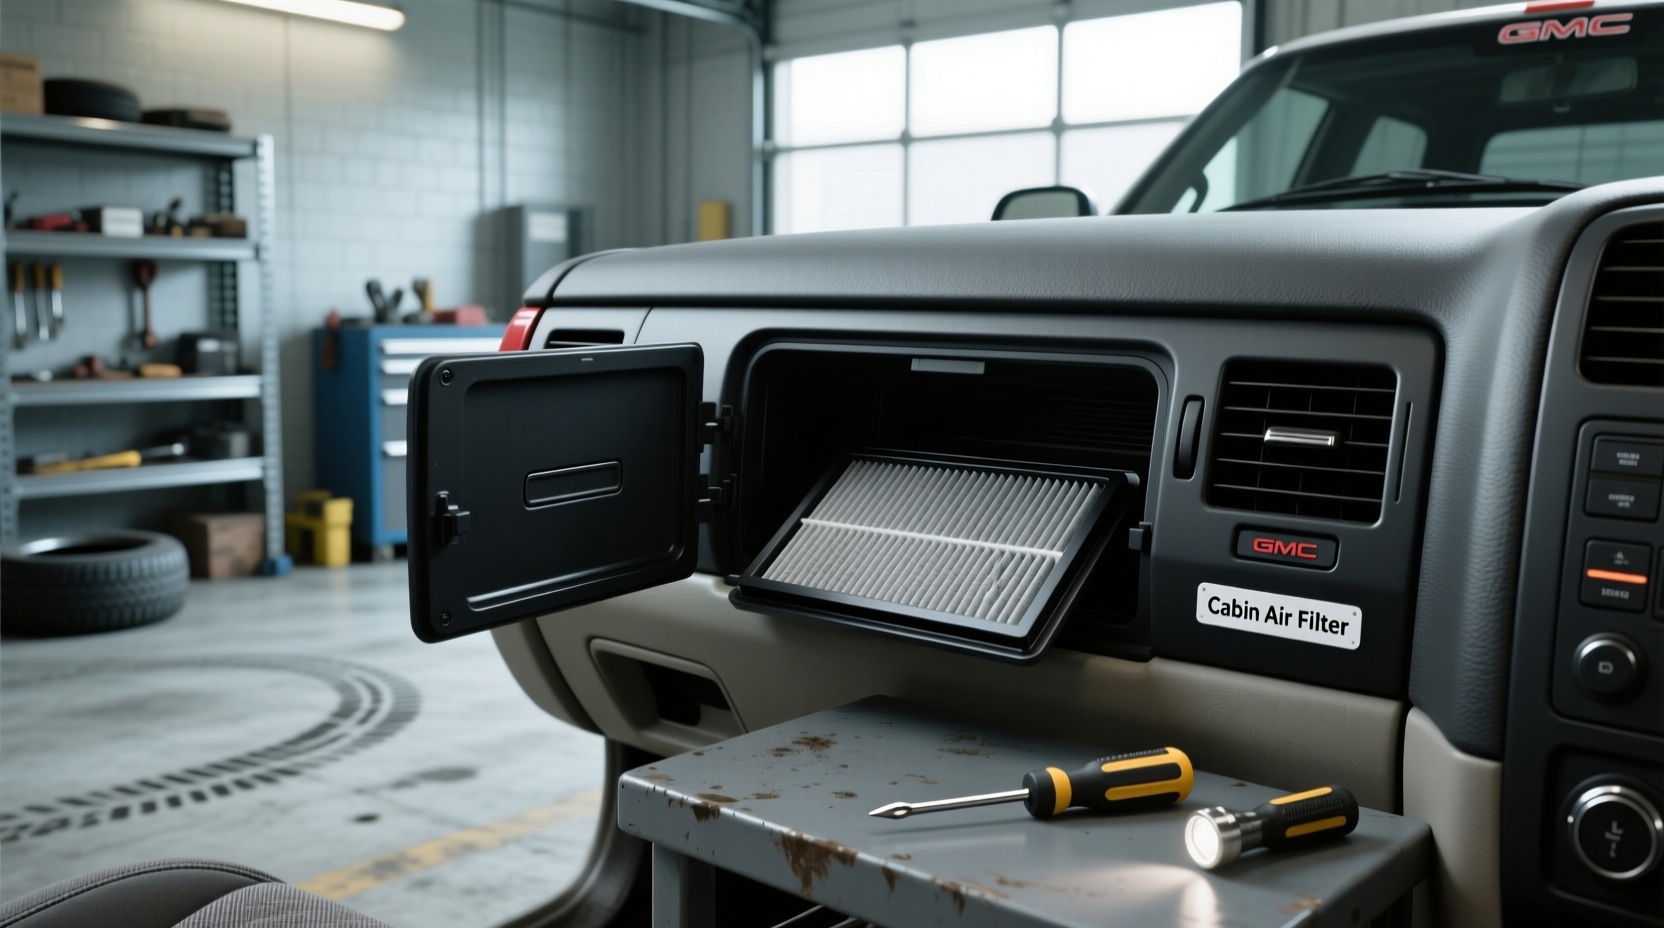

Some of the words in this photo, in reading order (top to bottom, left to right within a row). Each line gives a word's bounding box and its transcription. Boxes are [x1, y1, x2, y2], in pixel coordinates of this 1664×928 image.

[1497, 12, 1634, 45] GMC
[1252, 537, 1318, 560] GMC
[1207, 596, 1260, 622] Cabin
[1264, 605, 1293, 627] Air
[1298, 609, 1350, 636] Filter
